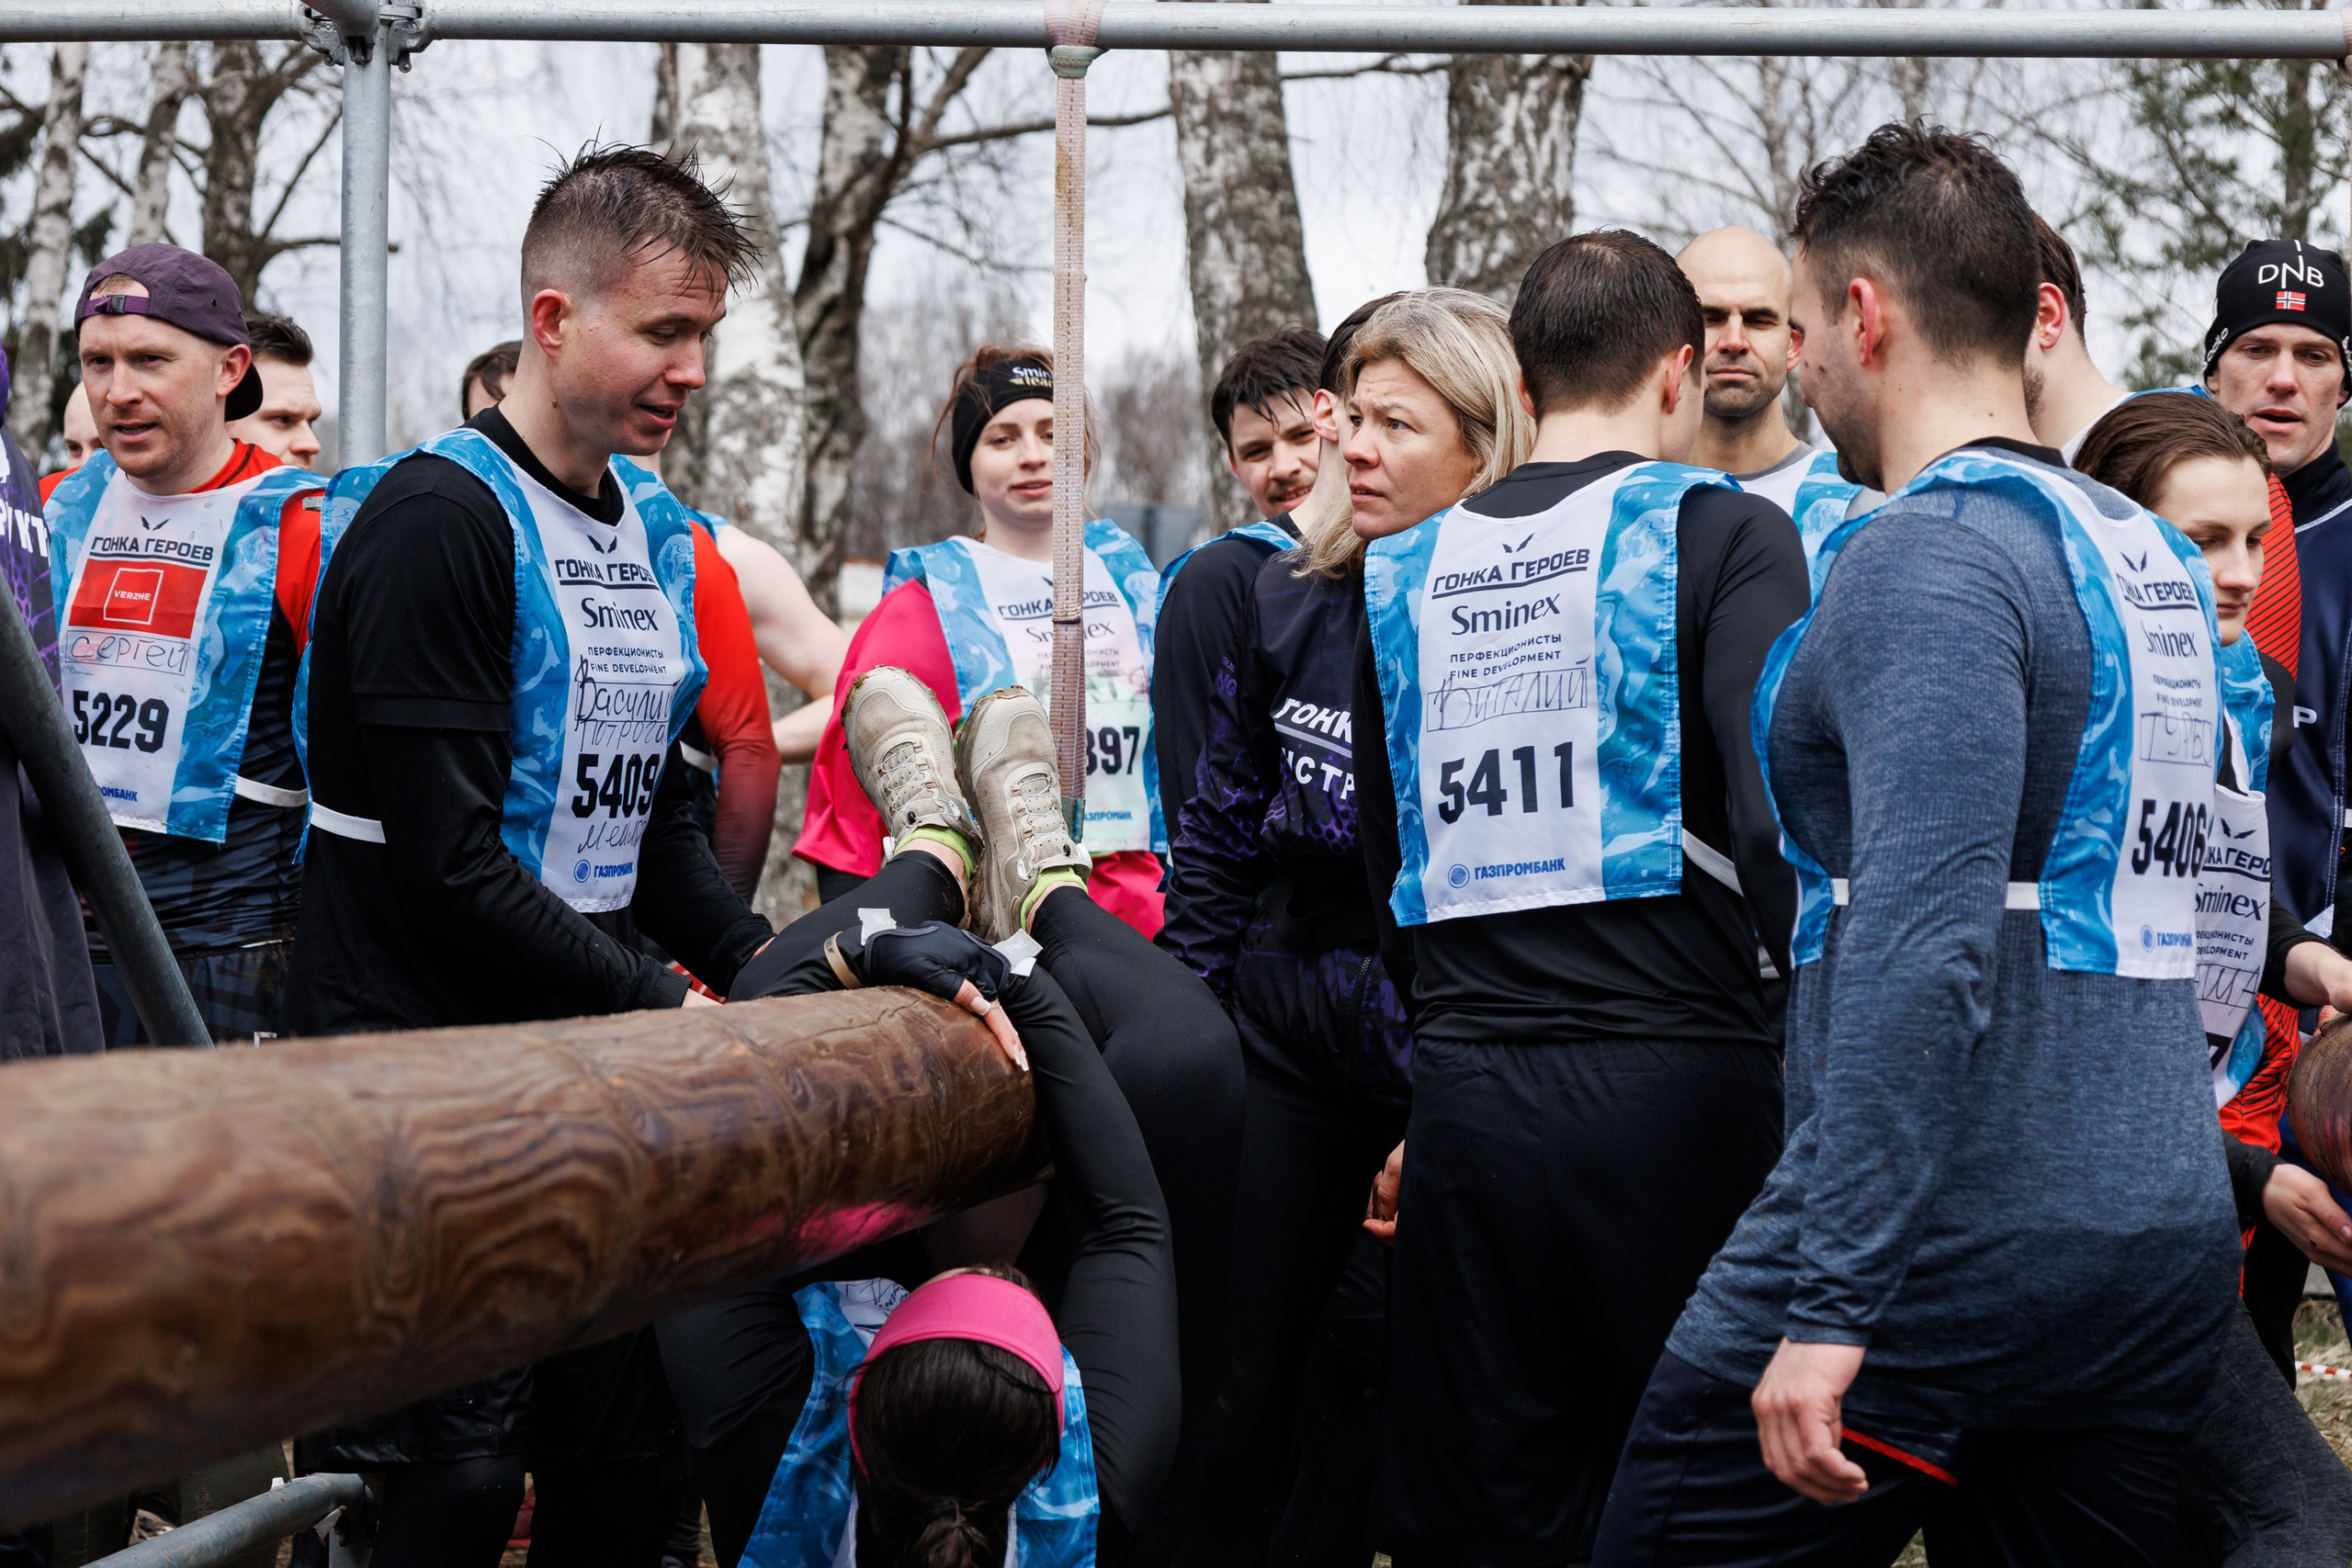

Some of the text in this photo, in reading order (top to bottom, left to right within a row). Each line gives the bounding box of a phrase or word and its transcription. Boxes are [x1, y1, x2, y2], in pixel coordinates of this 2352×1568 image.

[91, 536, 214, 560] ГОНКА ГЕРОЕВ
[554, 558, 605, 581] ГОНКА
[1433, 548, 1590, 592] ГОНКА ГЕРОЕВ
[114, 591, 152, 601] VERZHE
[1083, 592, 1118, 603] РОЕВ
[2143, 581, 2196, 603] ГЕРОЕВ
[581, 597, 660, 631] Sminex
[1452, 593, 1561, 636] Sminex
[588, 647, 664, 659] ПЕРФЕКЦИОНИСТЫ
[1450, 633, 1562, 663] ПЕРФЕКЦИОНИСТЫ
[591, 663, 667, 674] FINE DEVELOPMENT
[1450, 650, 1562, 679] FINE DEVELOPMENT
[73, 689, 170, 753] 5229
[97, 786, 138, 802] ОМБАНК
[571, 753, 661, 819] 5409
[1438, 740, 1574, 825] 5411
[2132, 798, 2207, 878] 5406
[1475, 857, 1566, 880] ГАЗПРОМБАНК
